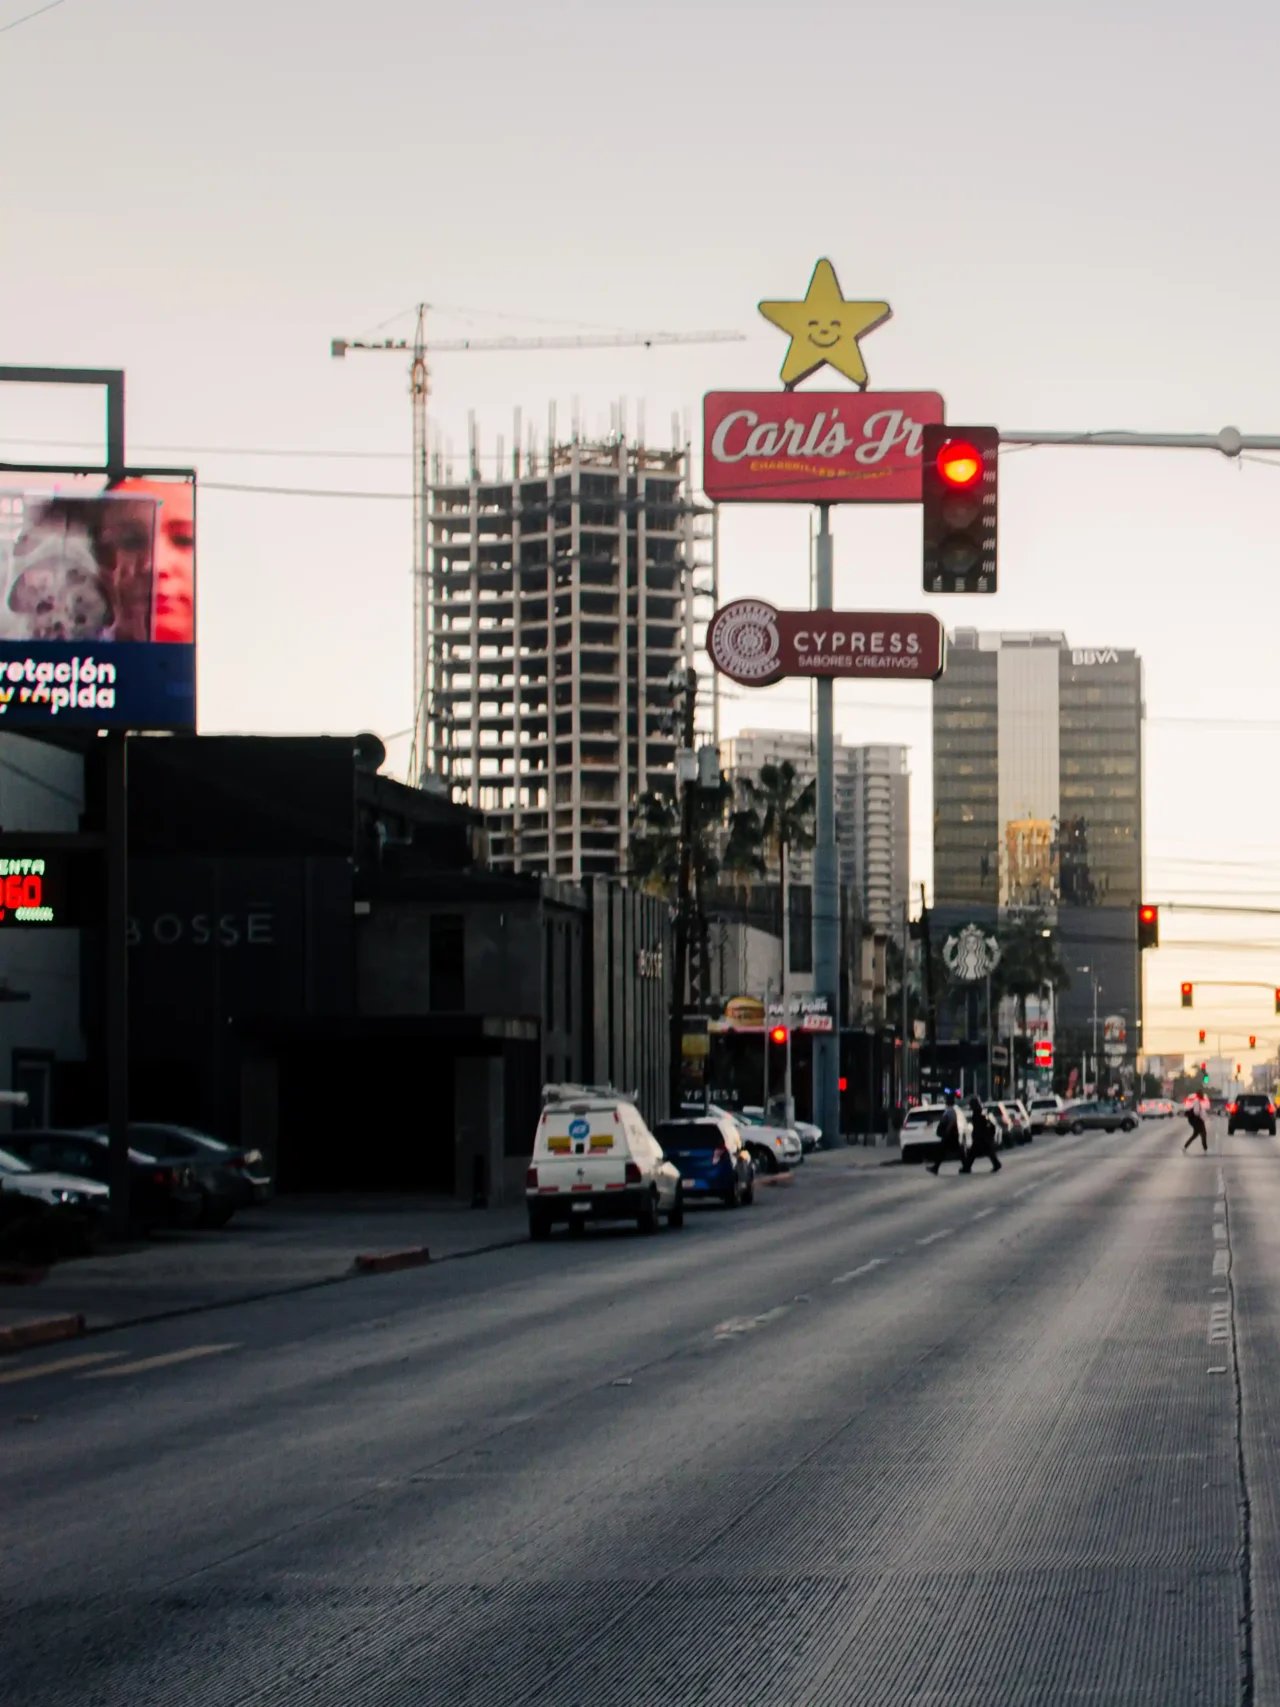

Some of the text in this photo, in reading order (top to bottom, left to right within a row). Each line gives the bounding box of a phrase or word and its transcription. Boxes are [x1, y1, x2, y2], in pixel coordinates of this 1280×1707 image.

[711, 408, 852, 462] Carl's
[793, 631, 920, 654] CYPRESS
[798, 656, 919, 669] SABORES CREATIVOS
[1072, 649, 1119, 665] BBVA
